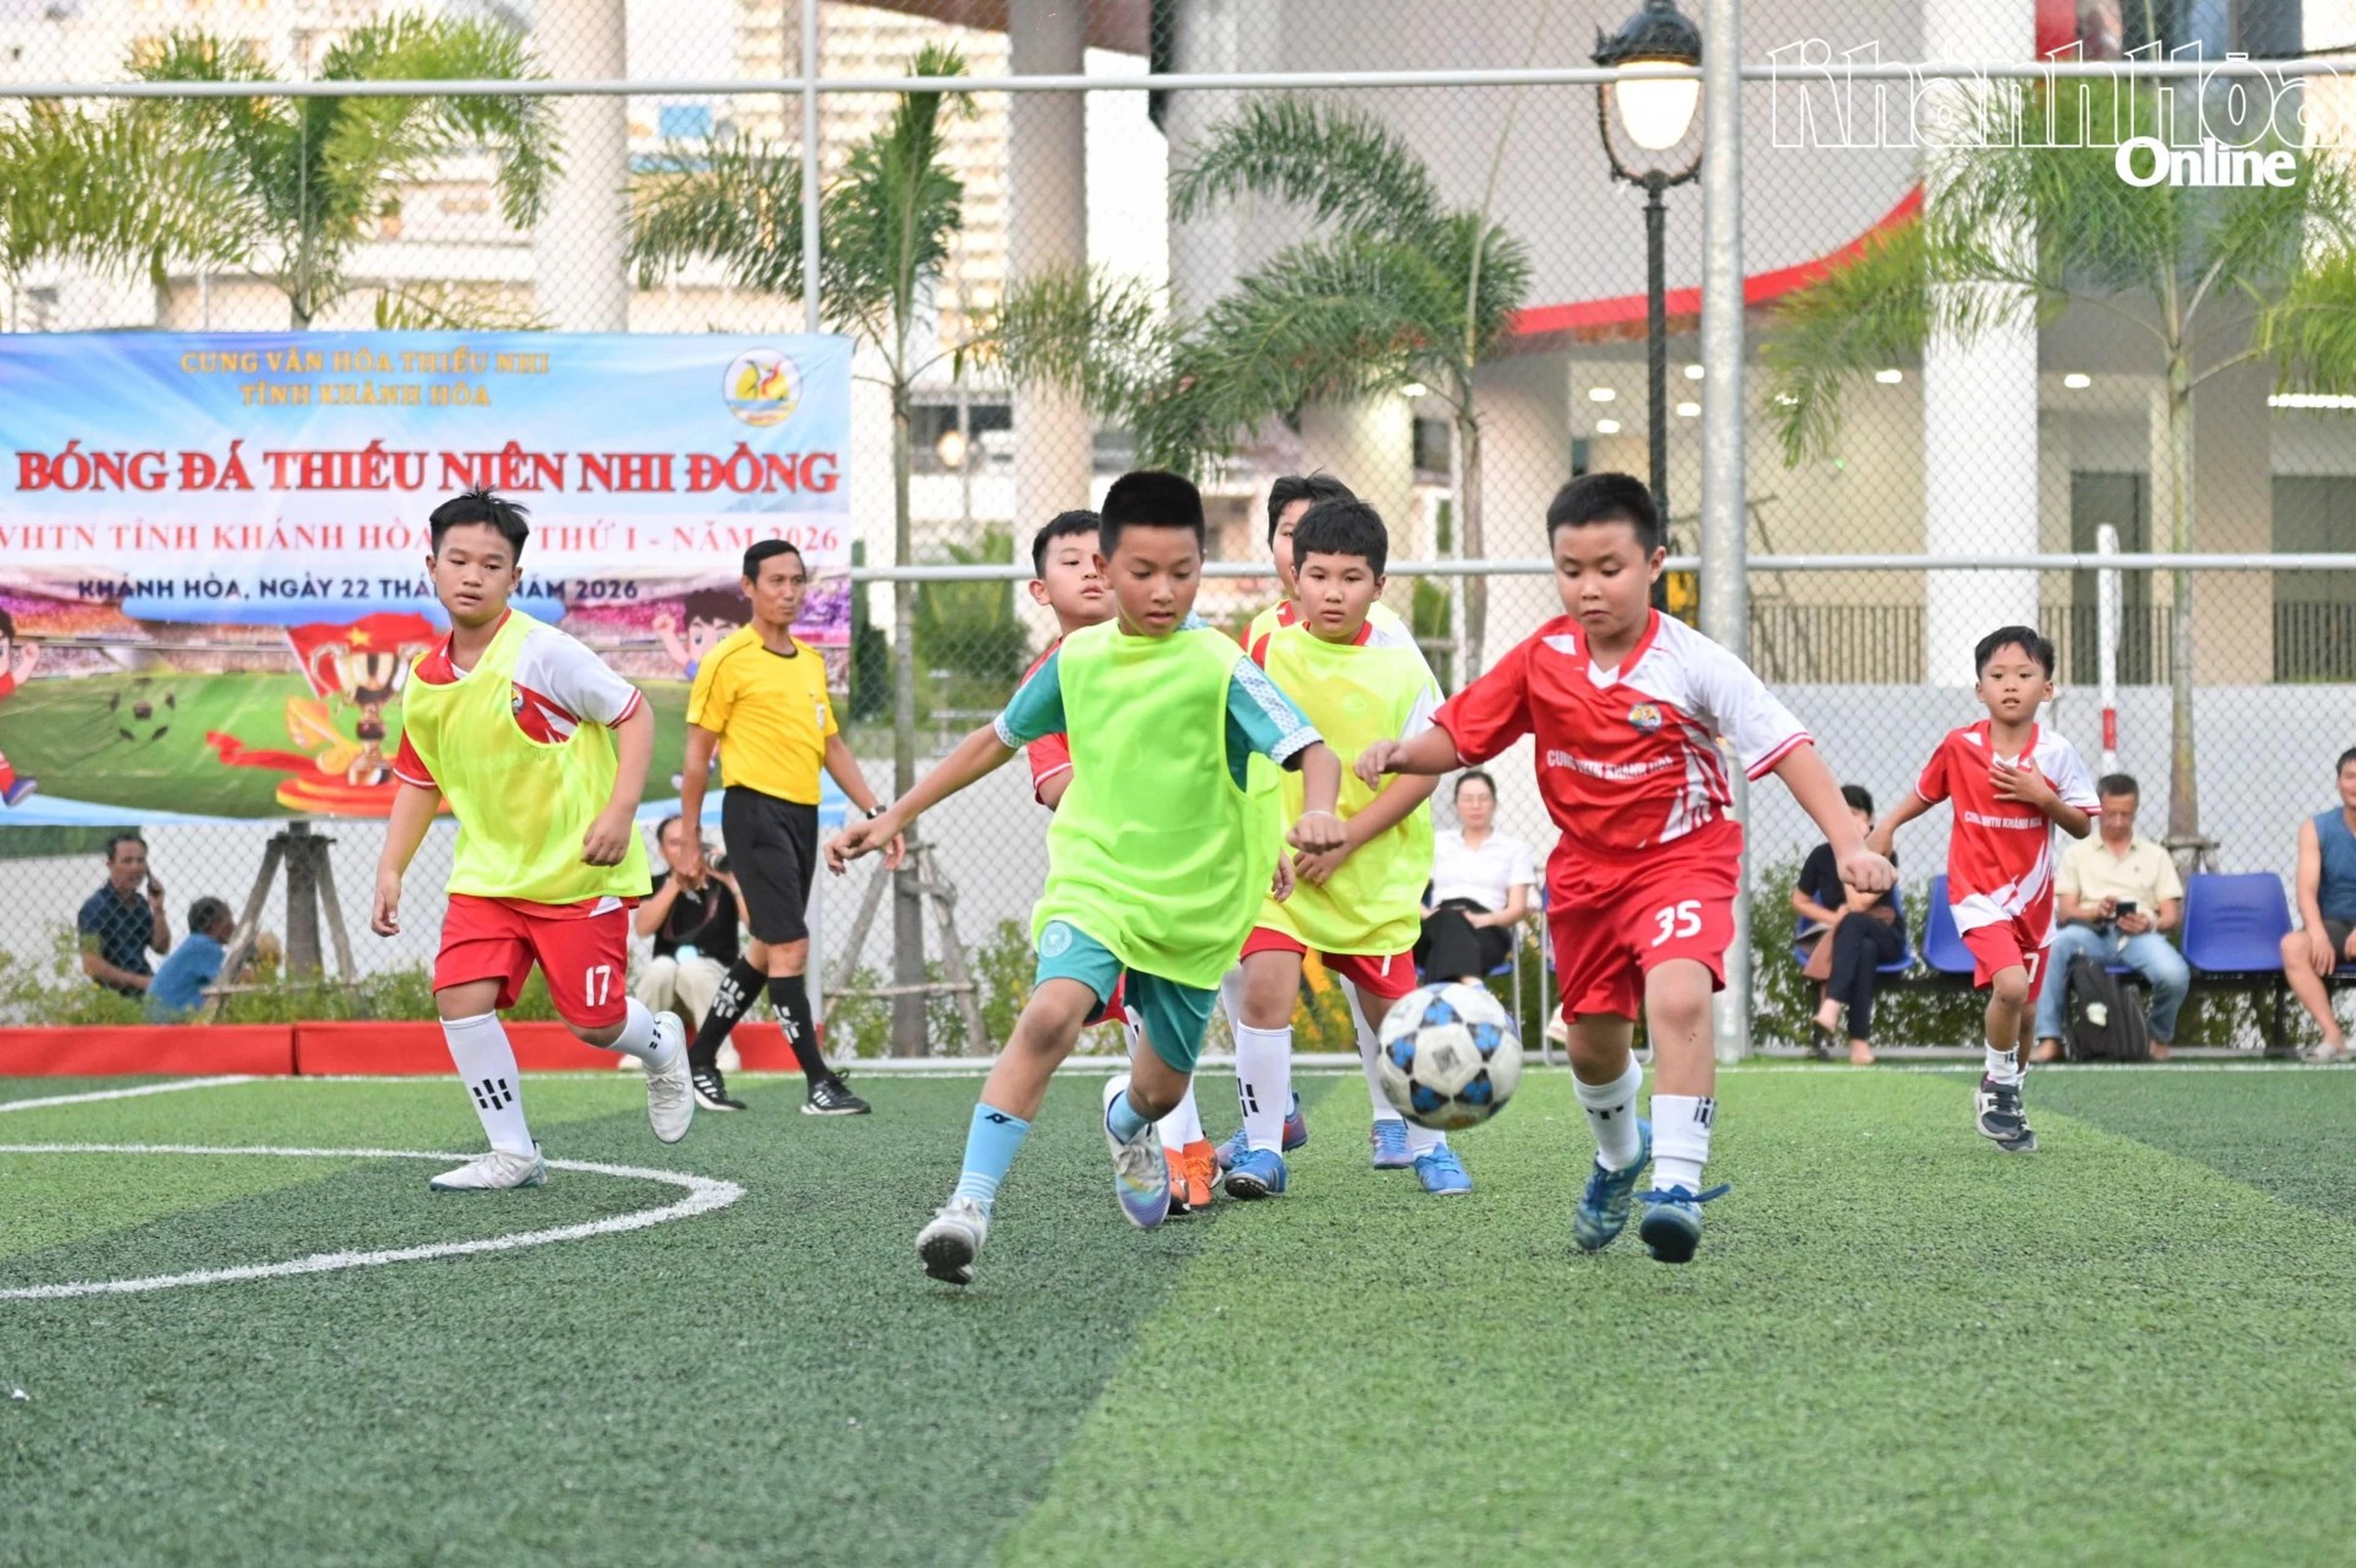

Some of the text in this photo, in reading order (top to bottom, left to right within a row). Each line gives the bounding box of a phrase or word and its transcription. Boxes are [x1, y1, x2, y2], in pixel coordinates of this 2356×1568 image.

[180, 351, 259, 374] CUNG
[495, 352, 550, 374] NHI
[15, 438, 841, 493] BÓNG ĐÁ THIẾU NIÊN NHI ĐỒNG
[0, 523, 96, 550] VHTN
[109, 517, 196, 550] TỈNH
[213, 517, 344, 550] KHÁNH
[359, 517, 431, 550] HÒA
[536, 519, 615, 551] THỨ
[626, 526, 636, 551] I
[672, 520, 755, 551] NĂM
[768, 525, 839, 551] 2026
[78, 572, 175, 599] KHÁNH
[183, 571, 250, 599] HÒA,
[260, 571, 334, 599] NGÀY
[341, 579, 371, 599] 22
[379, 572, 439, 599] THÁ
[575, 580, 639, 599] 2026
[1651, 899, 1703, 948] 35
[586, 964, 611, 1007] 17
